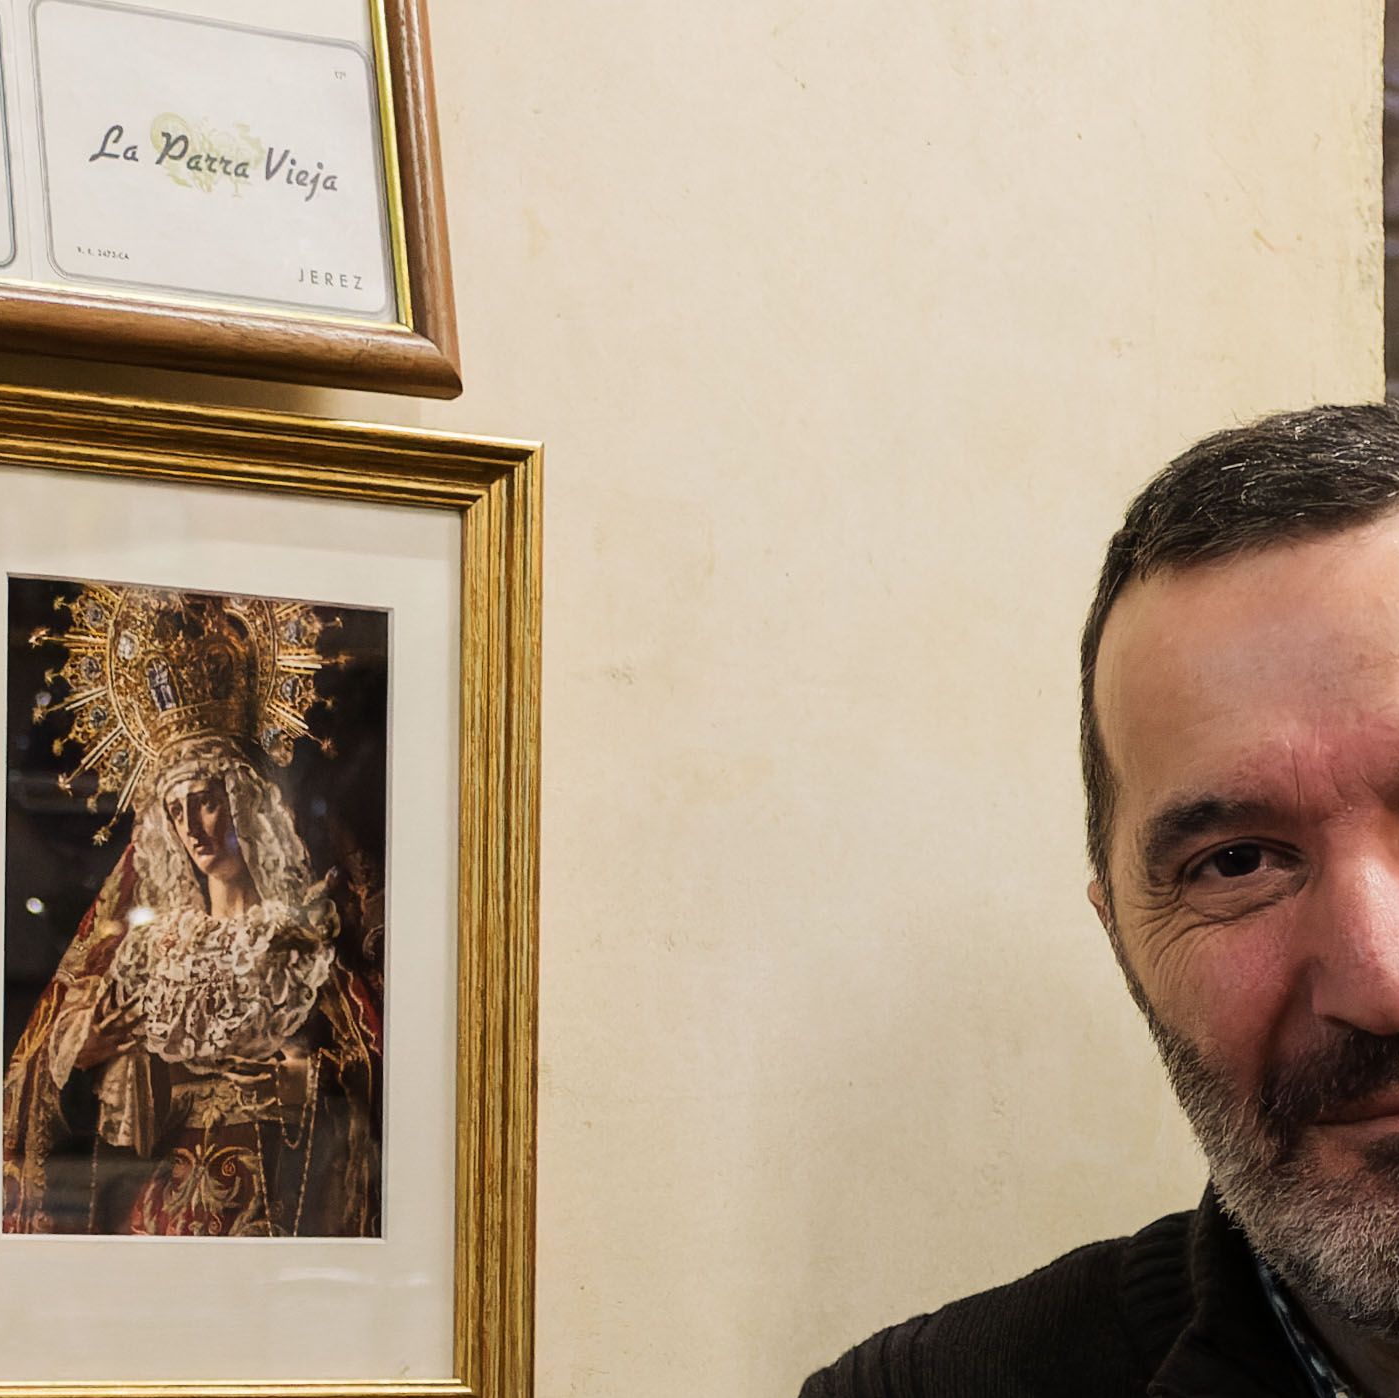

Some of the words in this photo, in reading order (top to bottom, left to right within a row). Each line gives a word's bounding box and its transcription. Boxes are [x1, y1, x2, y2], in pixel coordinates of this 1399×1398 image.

[88, 124, 139, 163] La
[155, 131, 250, 179] Parra
[264, 147, 339, 202] Vieja
[298, 267, 364, 292] JEREZ
